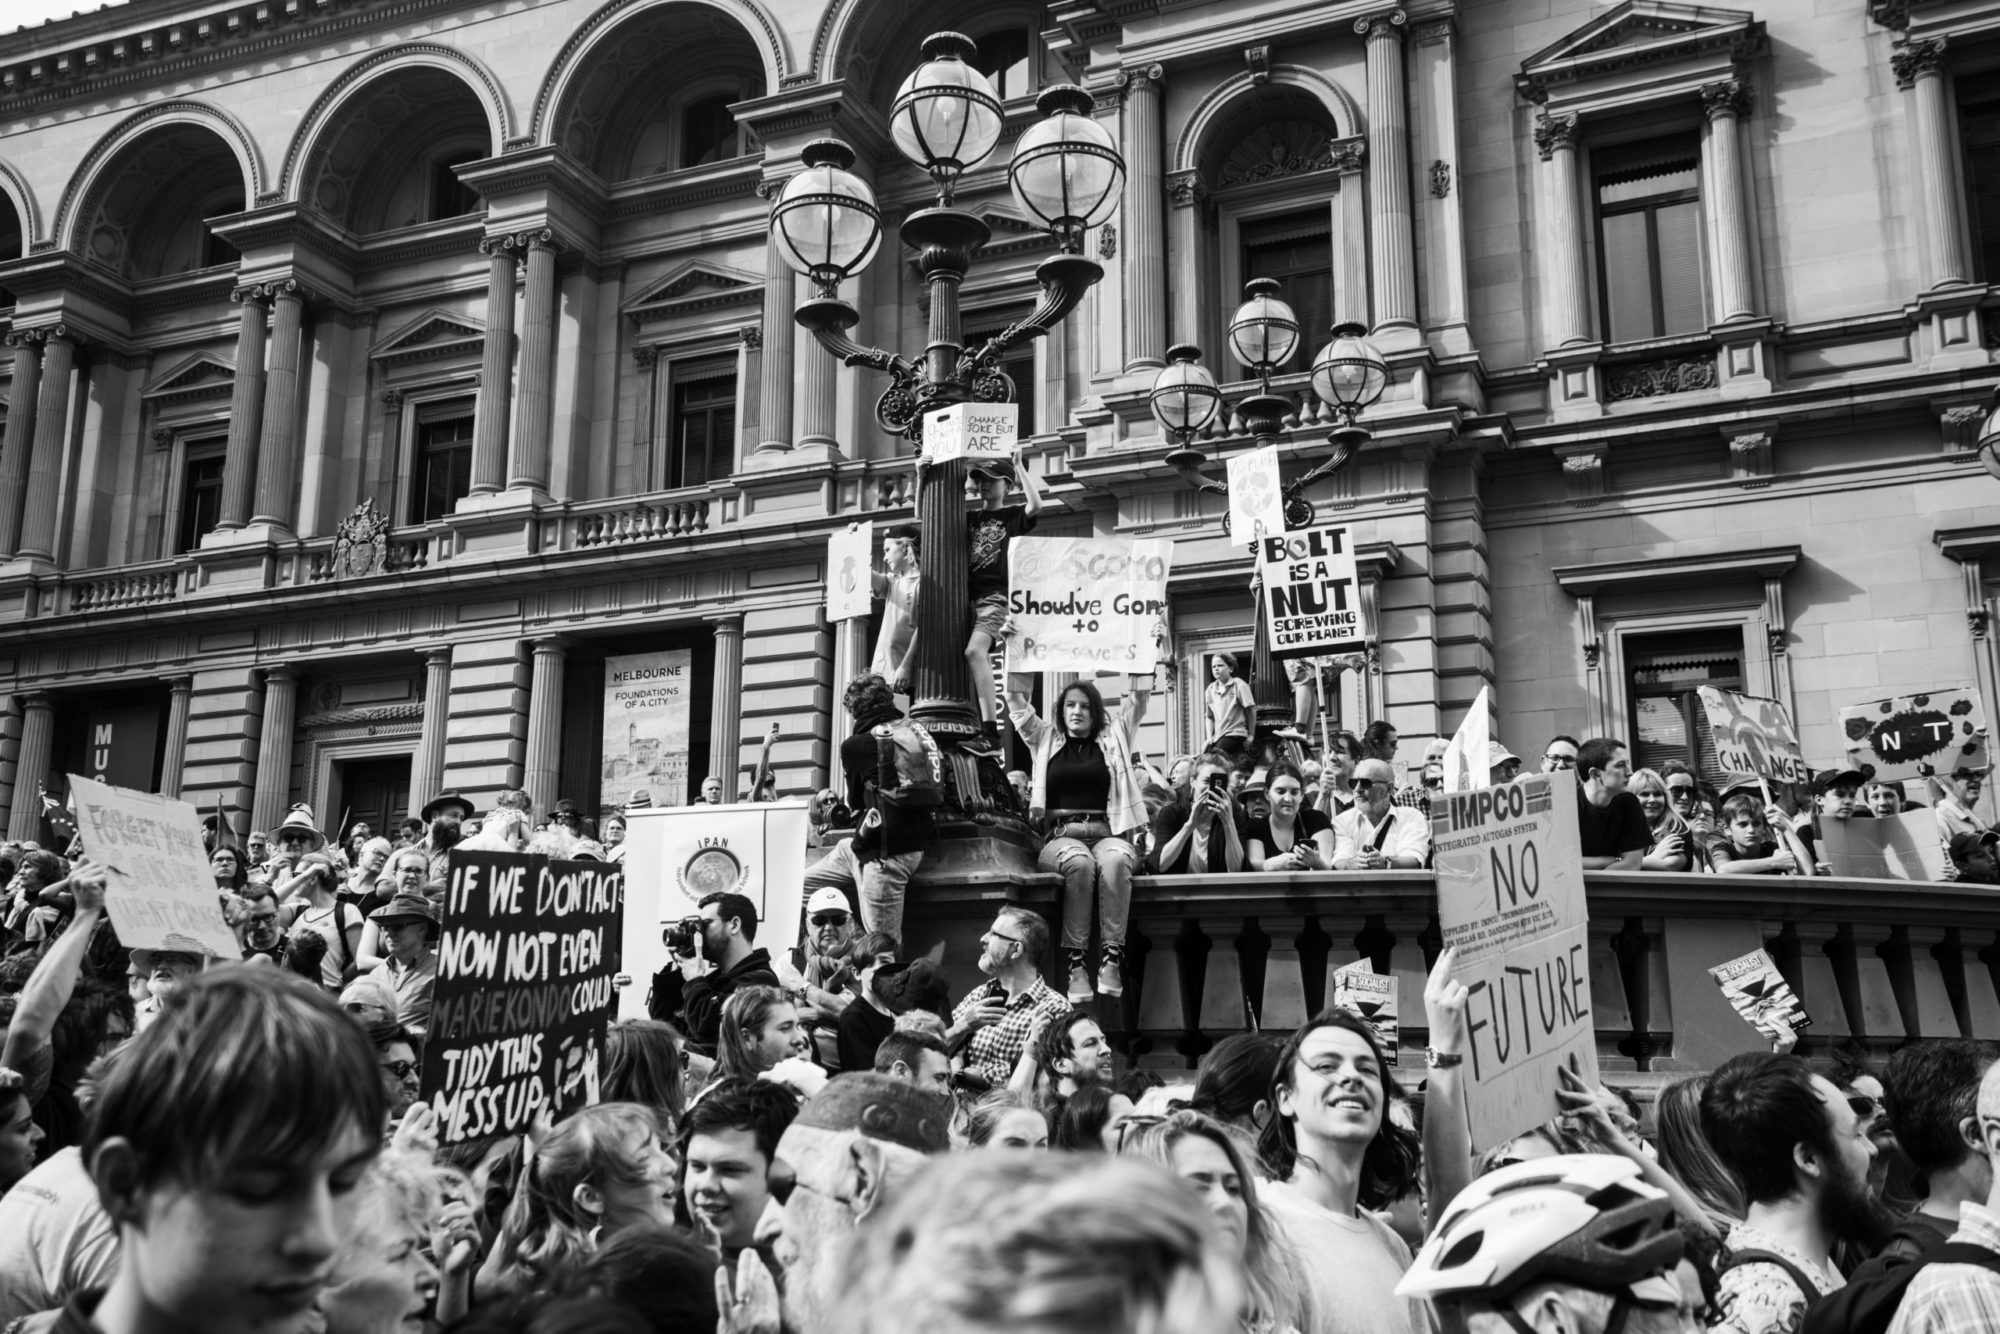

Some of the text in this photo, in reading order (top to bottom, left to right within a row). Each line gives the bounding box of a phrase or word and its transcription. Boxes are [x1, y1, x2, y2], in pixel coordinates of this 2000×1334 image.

[967, 424, 992, 433] JOKE
[996, 425, 1014, 434] BUT
[968, 416, 1008, 425] CHANGE
[967, 436, 1001, 451] ARE
[1264, 527, 1347, 564] BOLT
[1315, 561, 1328, 579] A
[1271, 577, 1352, 619] NUT
[1072, 619, 1099, 633] to
[1277, 625, 1357, 645] OUR PLANET
[614, 666, 682, 682] MELBOURNE
[615, 687, 679, 700] FOUNDATIONS
[625, 701, 637, 709] OF
[648, 698, 668, 707] CITY
[912, 722, 940, 783] adidas
[1720, 750, 1806, 785] CHANGE
[1450, 784, 1524, 832] IMPCO
[1513, 821, 1538, 835] SYSTEM
[698, 836, 729, 849] IPAN
[450, 865, 480, 916] IF
[488, 865, 527, 917] WE
[591, 872, 620, 914] ACT
[1490, 840, 1539, 915] NO
[1442, 924, 1469, 938] UPPLIED
[438, 926, 604, 983] NOW NOT EVEN
[502, 983, 571, 1034] KONDO
[571, 974, 611, 1016] COULD
[1464, 943, 1589, 1082] FUTURE
[442, 1032, 544, 1091] TIDY THIS
[432, 1075, 544, 1142] MESS UP
